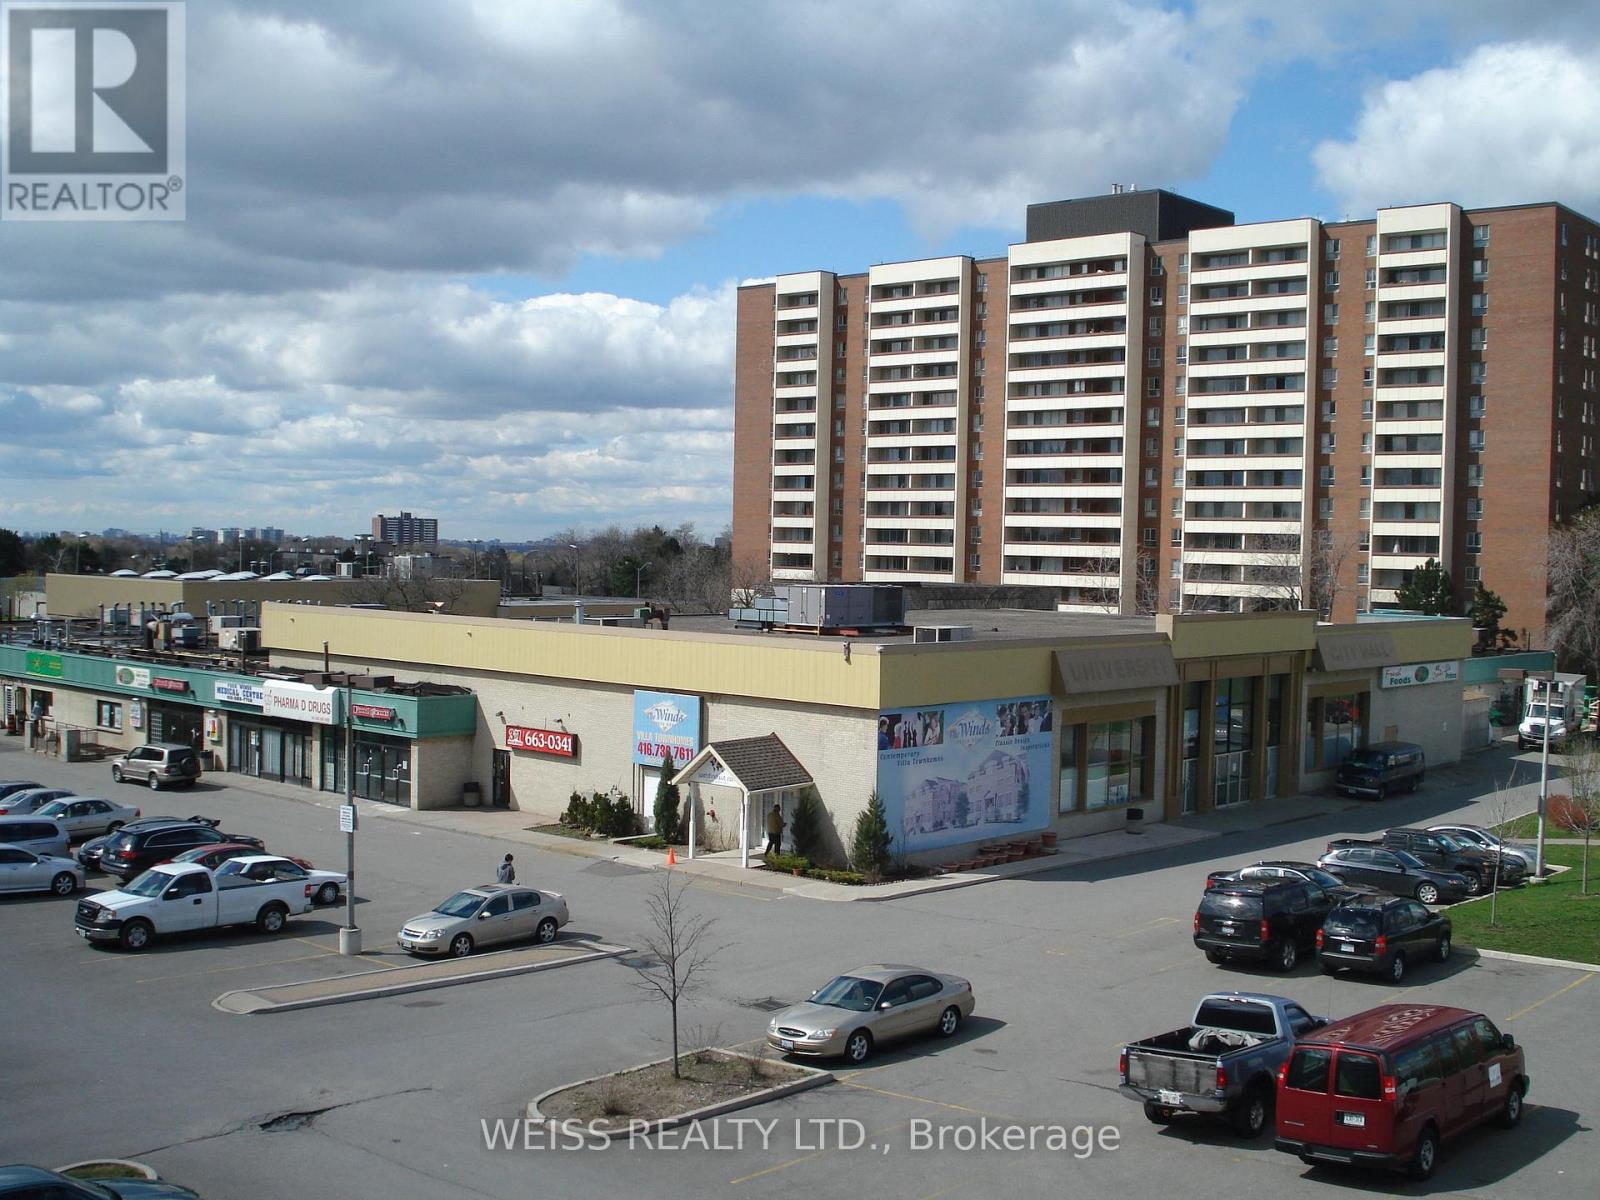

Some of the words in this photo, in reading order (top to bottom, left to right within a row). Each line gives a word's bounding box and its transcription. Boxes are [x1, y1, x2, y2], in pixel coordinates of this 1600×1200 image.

[1389, 676, 1411, 685] Foods
[216, 686, 239, 697] MEDICAL
[242, 689, 263, 700] CENTRE
[273, 696, 299, 710] PHARMA
[301, 700, 306, 711] D
[308, 701, 331, 715] DRUGS
[655, 708, 684, 722] Winds
[959, 720, 990, 737] Winds
[525, 731, 572, 751] 663-0341
